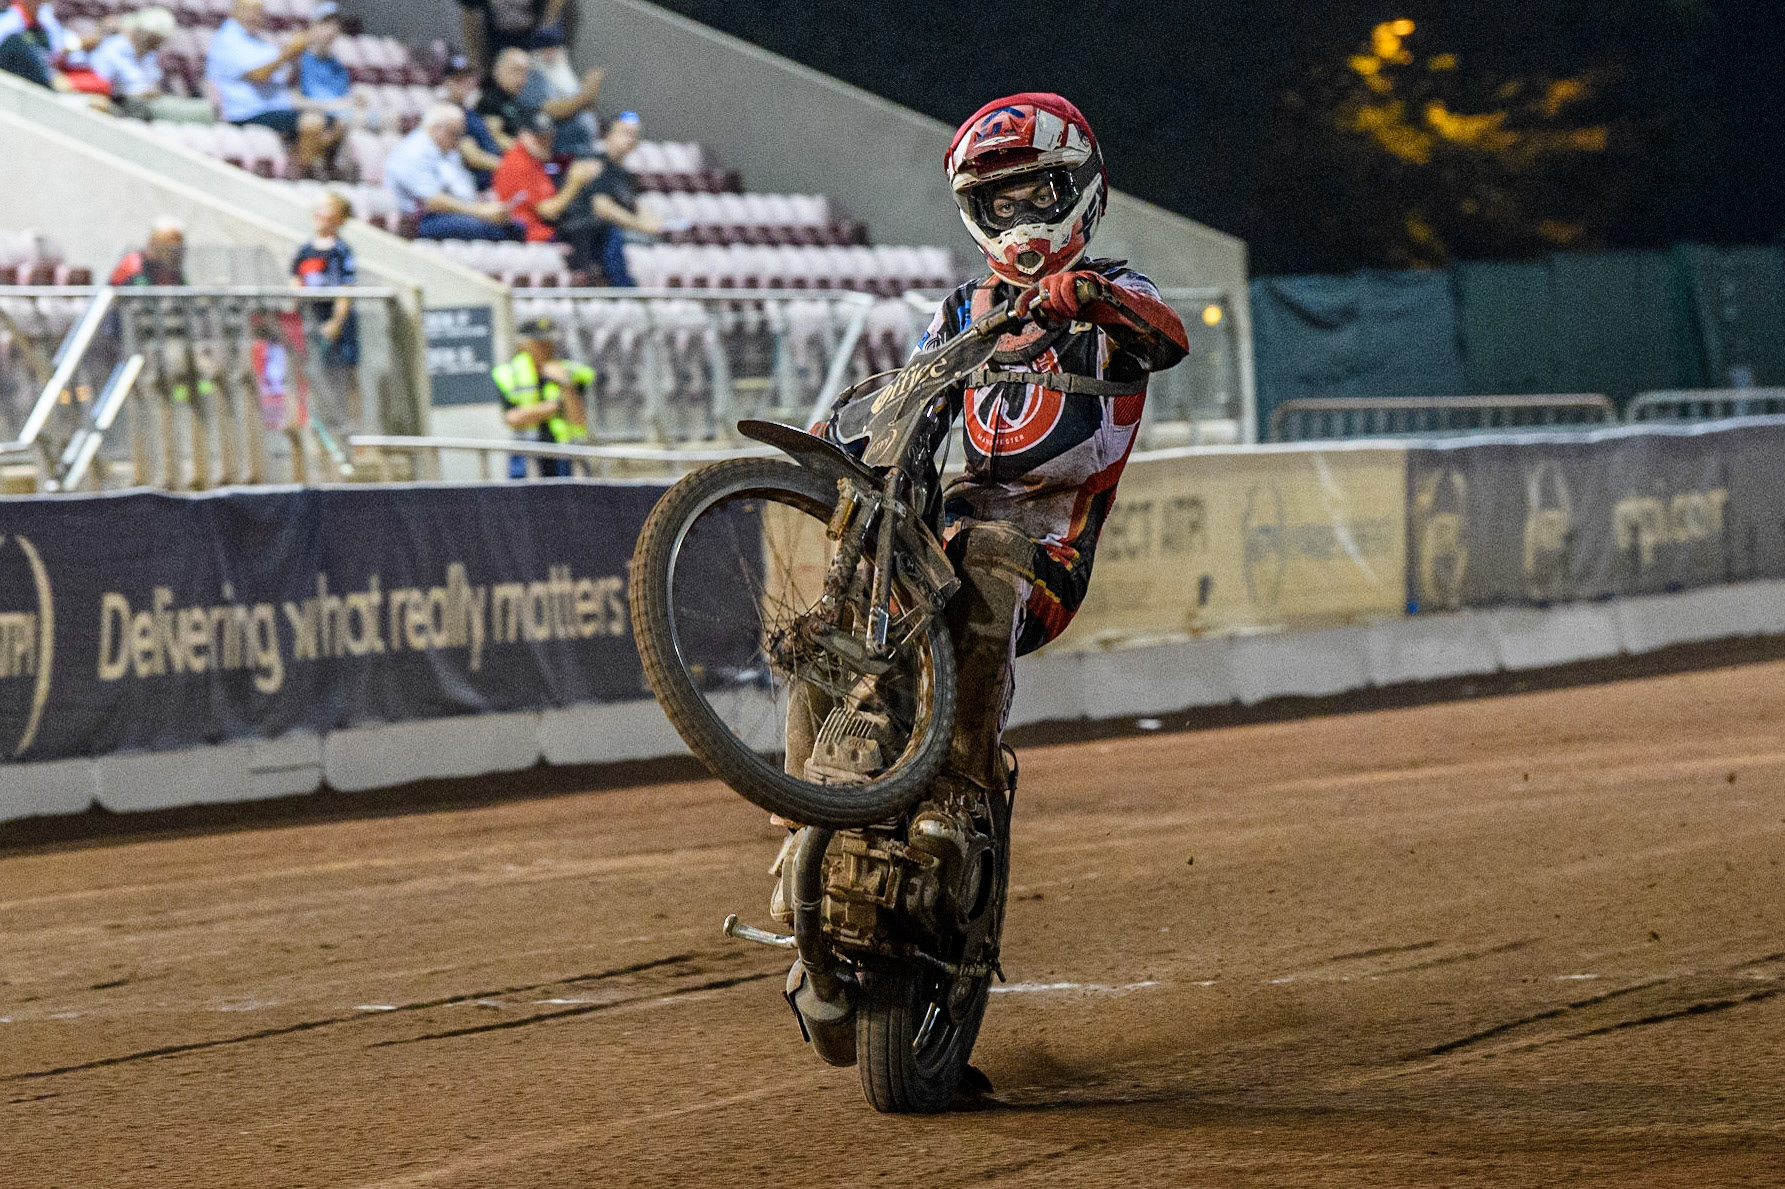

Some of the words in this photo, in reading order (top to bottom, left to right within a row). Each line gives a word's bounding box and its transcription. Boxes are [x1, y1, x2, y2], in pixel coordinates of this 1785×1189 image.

[977, 433, 1025, 447] MANCESTER
[97, 583, 285, 694] Delivering
[389, 562, 486, 671] really
[493, 563, 626, 642] matters
